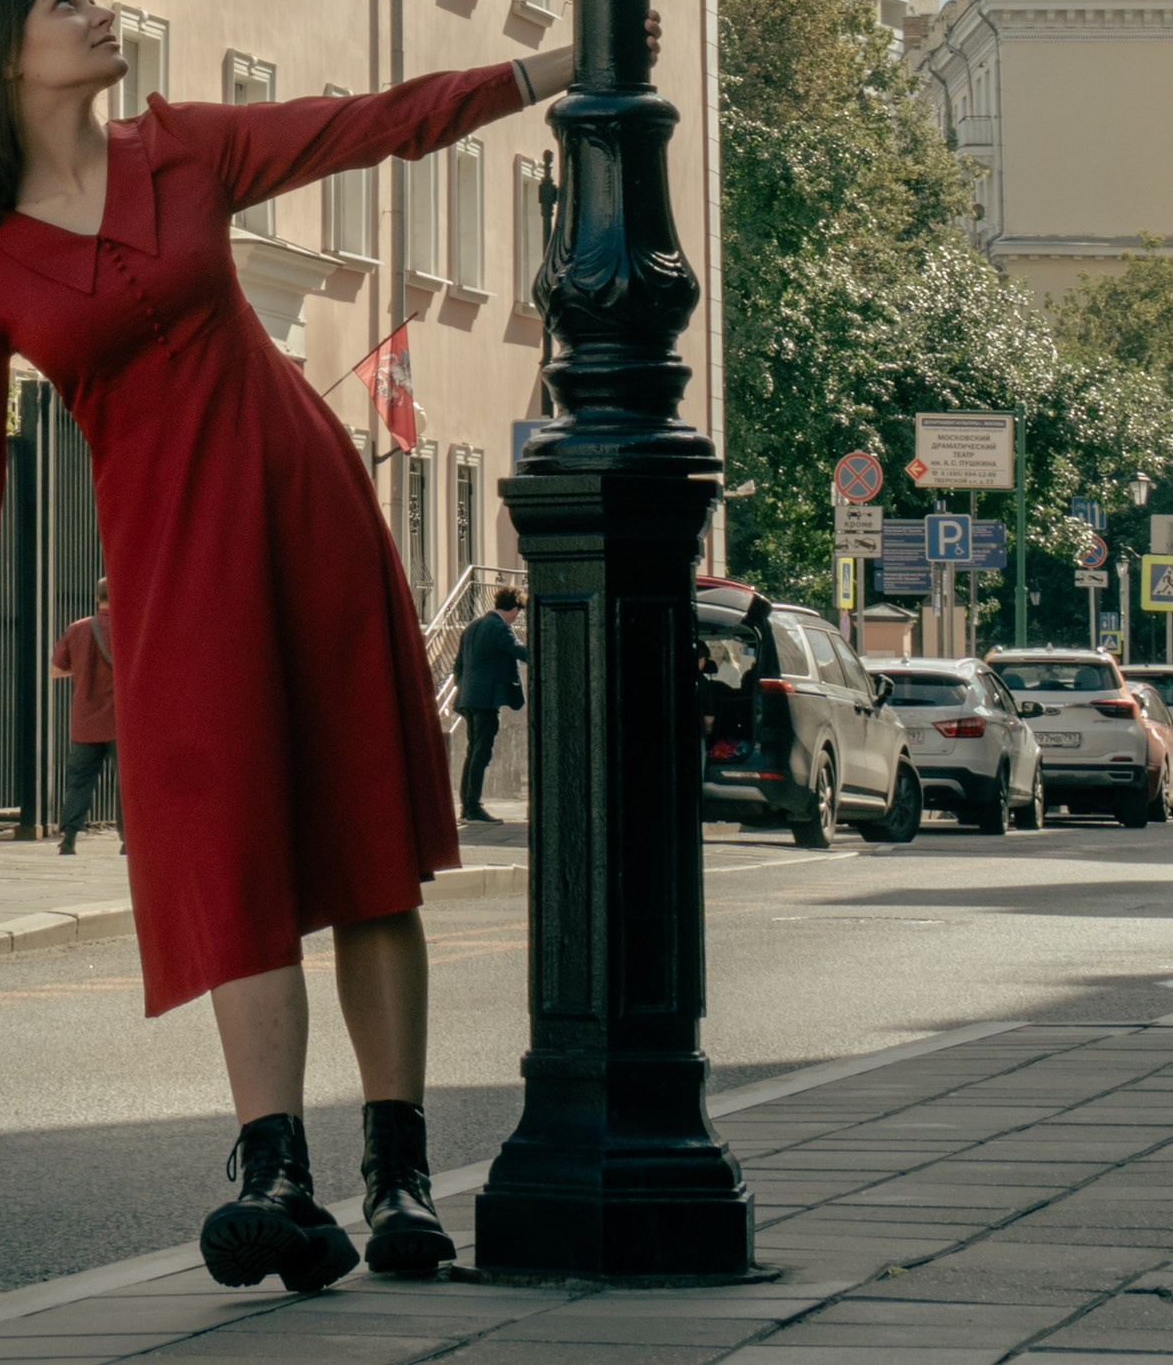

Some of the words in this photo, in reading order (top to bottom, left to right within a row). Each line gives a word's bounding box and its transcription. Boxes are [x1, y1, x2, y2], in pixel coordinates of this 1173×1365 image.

[931, 442, 996, 450] ДРАМАТИЧЕСКИЙ
[844, 520, 873, 529] кроме
[938, 520, 963, 556] P
